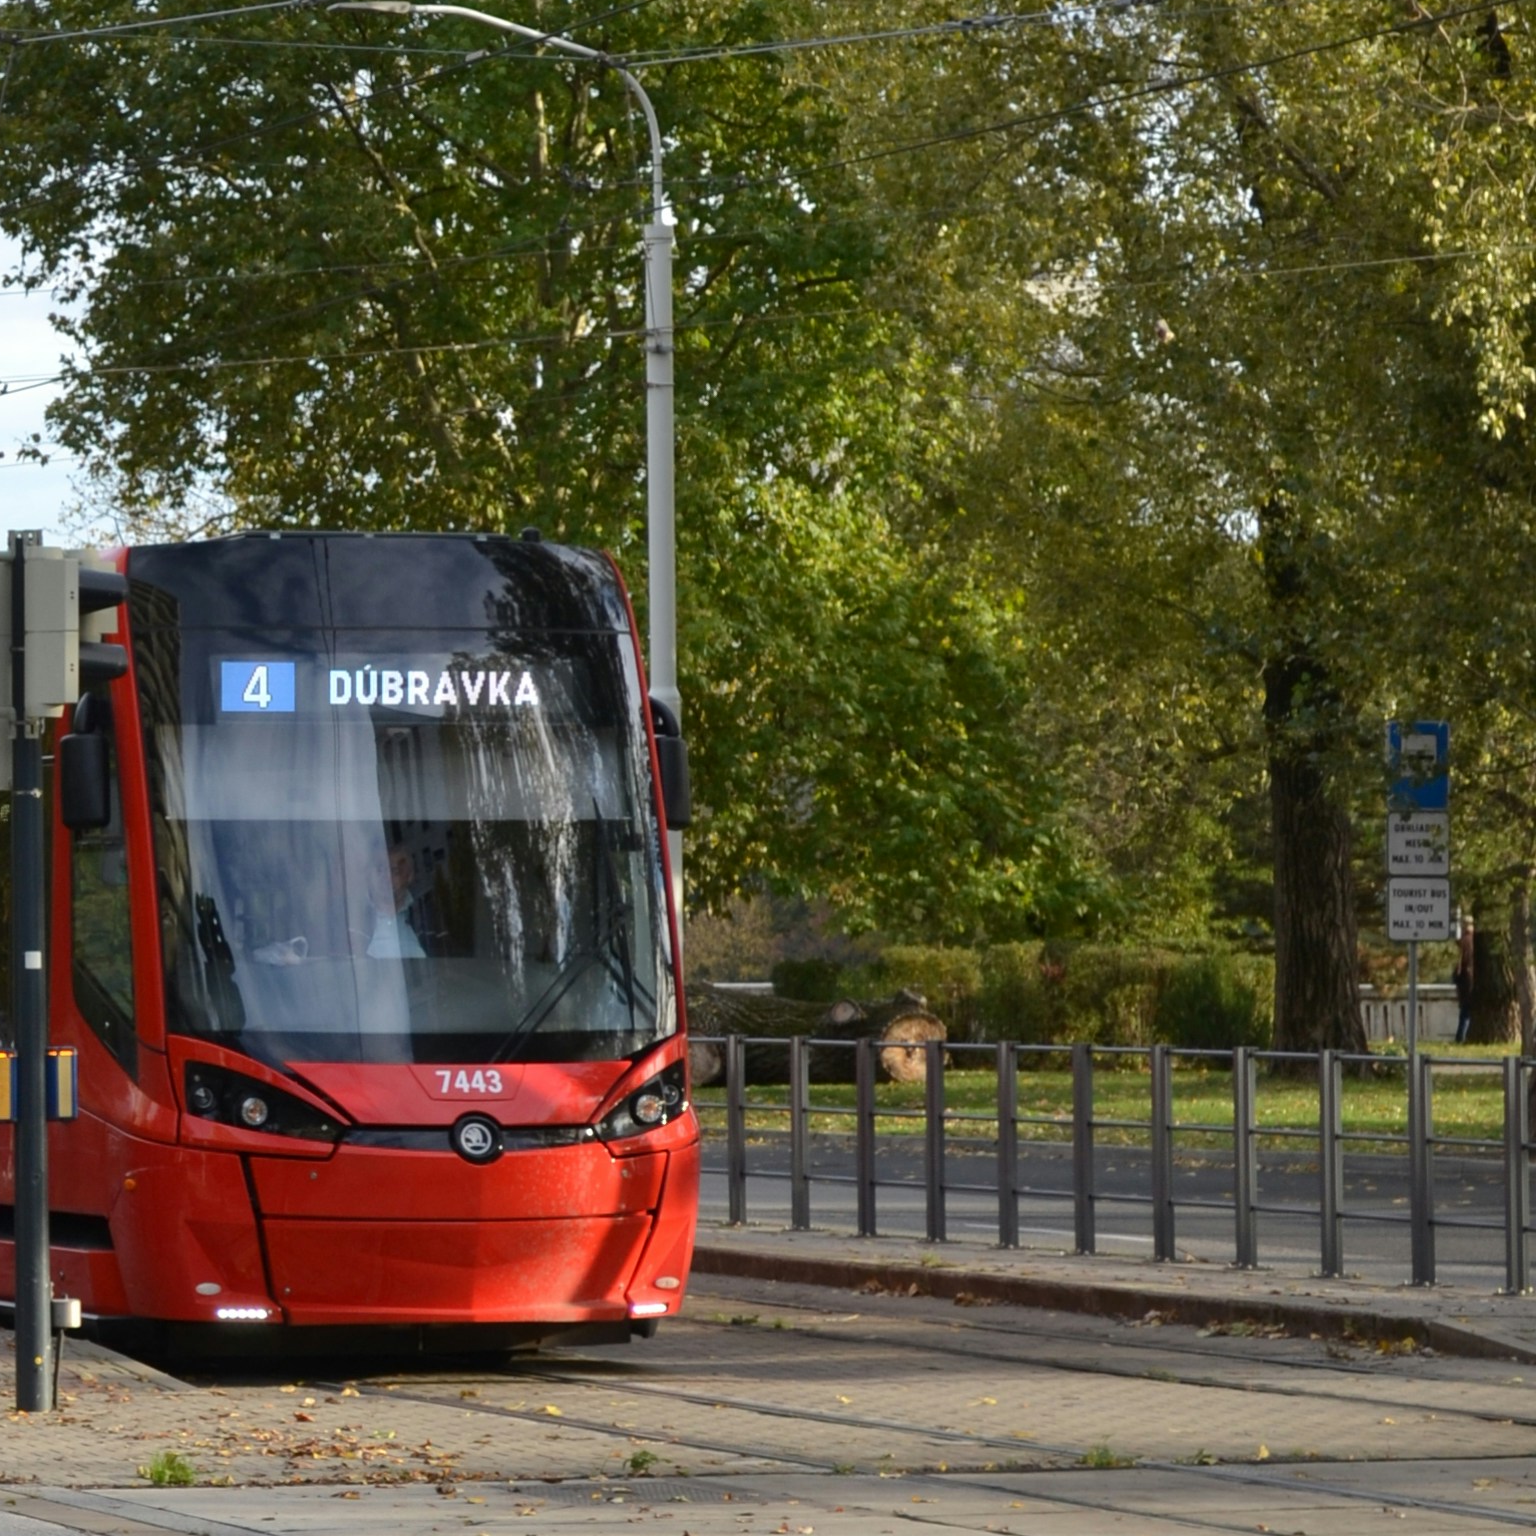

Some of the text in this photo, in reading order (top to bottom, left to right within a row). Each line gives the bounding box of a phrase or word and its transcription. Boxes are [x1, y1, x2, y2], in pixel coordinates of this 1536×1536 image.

[242, 664, 539, 709] 4 DÚBRAVKA
[1414, 854, 1424, 864] 10
[1393, 888, 1447, 899] TOURIST BUS
[1415, 919, 1425, 929] 10
[435, 1069, 503, 1094] 7443
